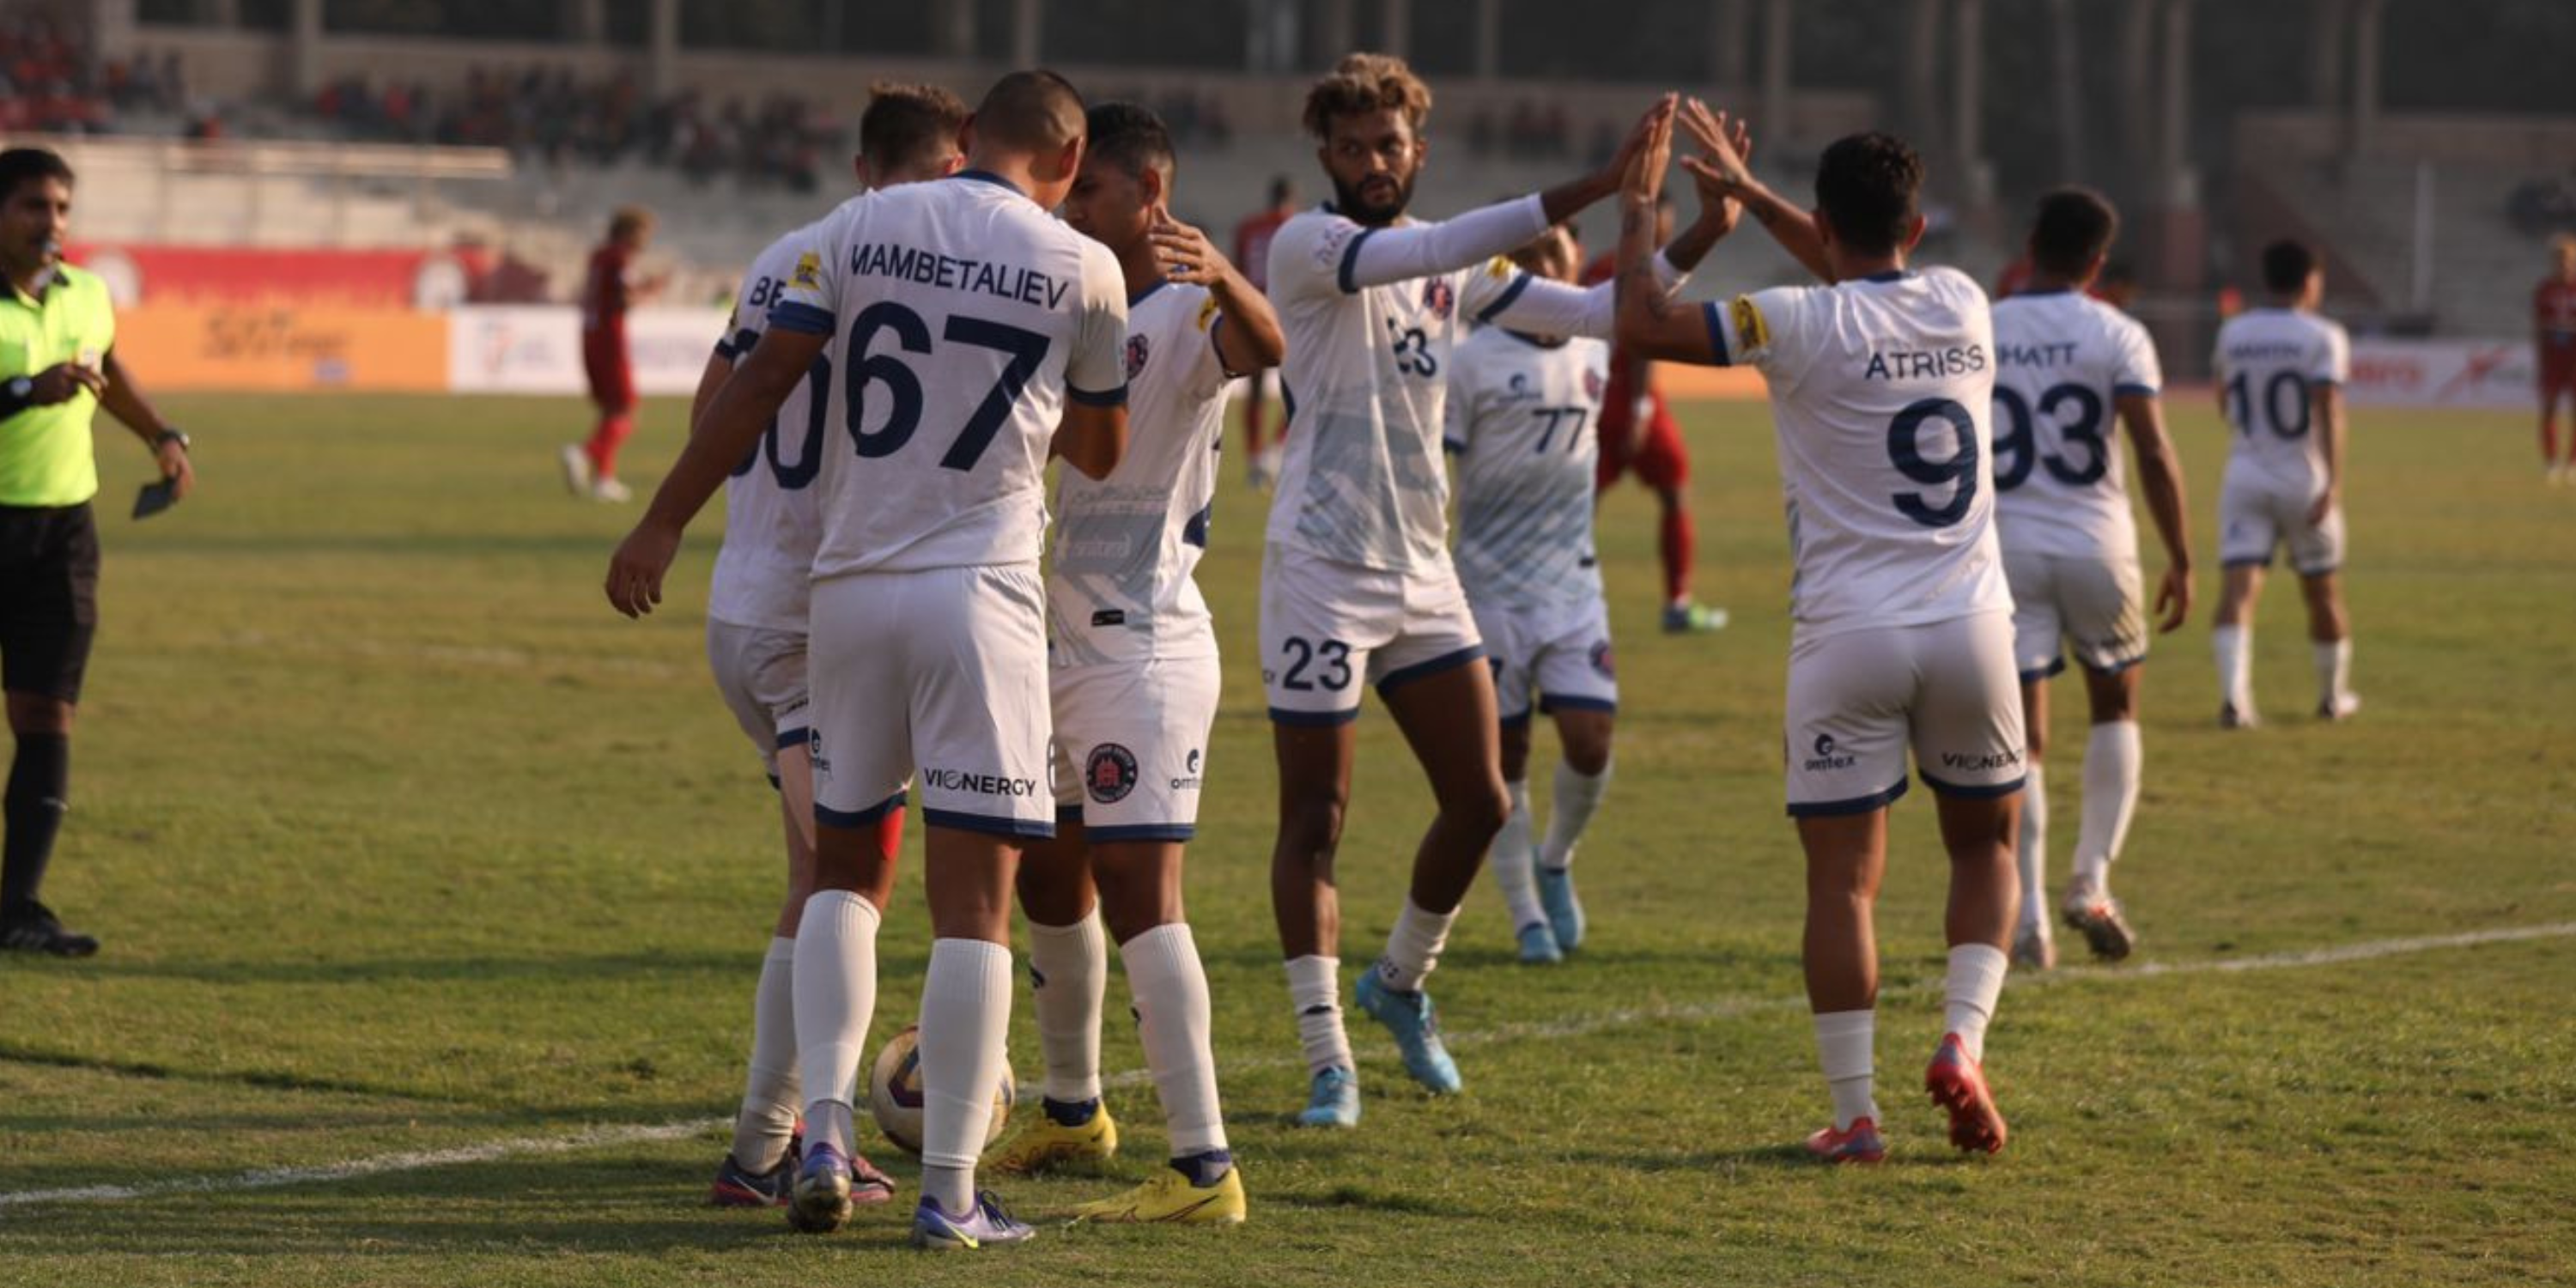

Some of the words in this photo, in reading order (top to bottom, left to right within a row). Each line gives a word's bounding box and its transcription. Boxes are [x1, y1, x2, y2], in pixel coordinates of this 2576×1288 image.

[851, 244, 1069, 310] MAMBETALIEV
[845, 301, 1052, 472] 67
[1865, 344, 1986, 380] ATRISS
[1996, 342, 2078, 368] HATT
[1532, 407, 1588, 453] 77
[1992, 384, 2106, 492] 93
[2228, 371, 2310, 440] 10
[1888, 398, 1978, 528] 9
[1283, 636, 1352, 692] 23
